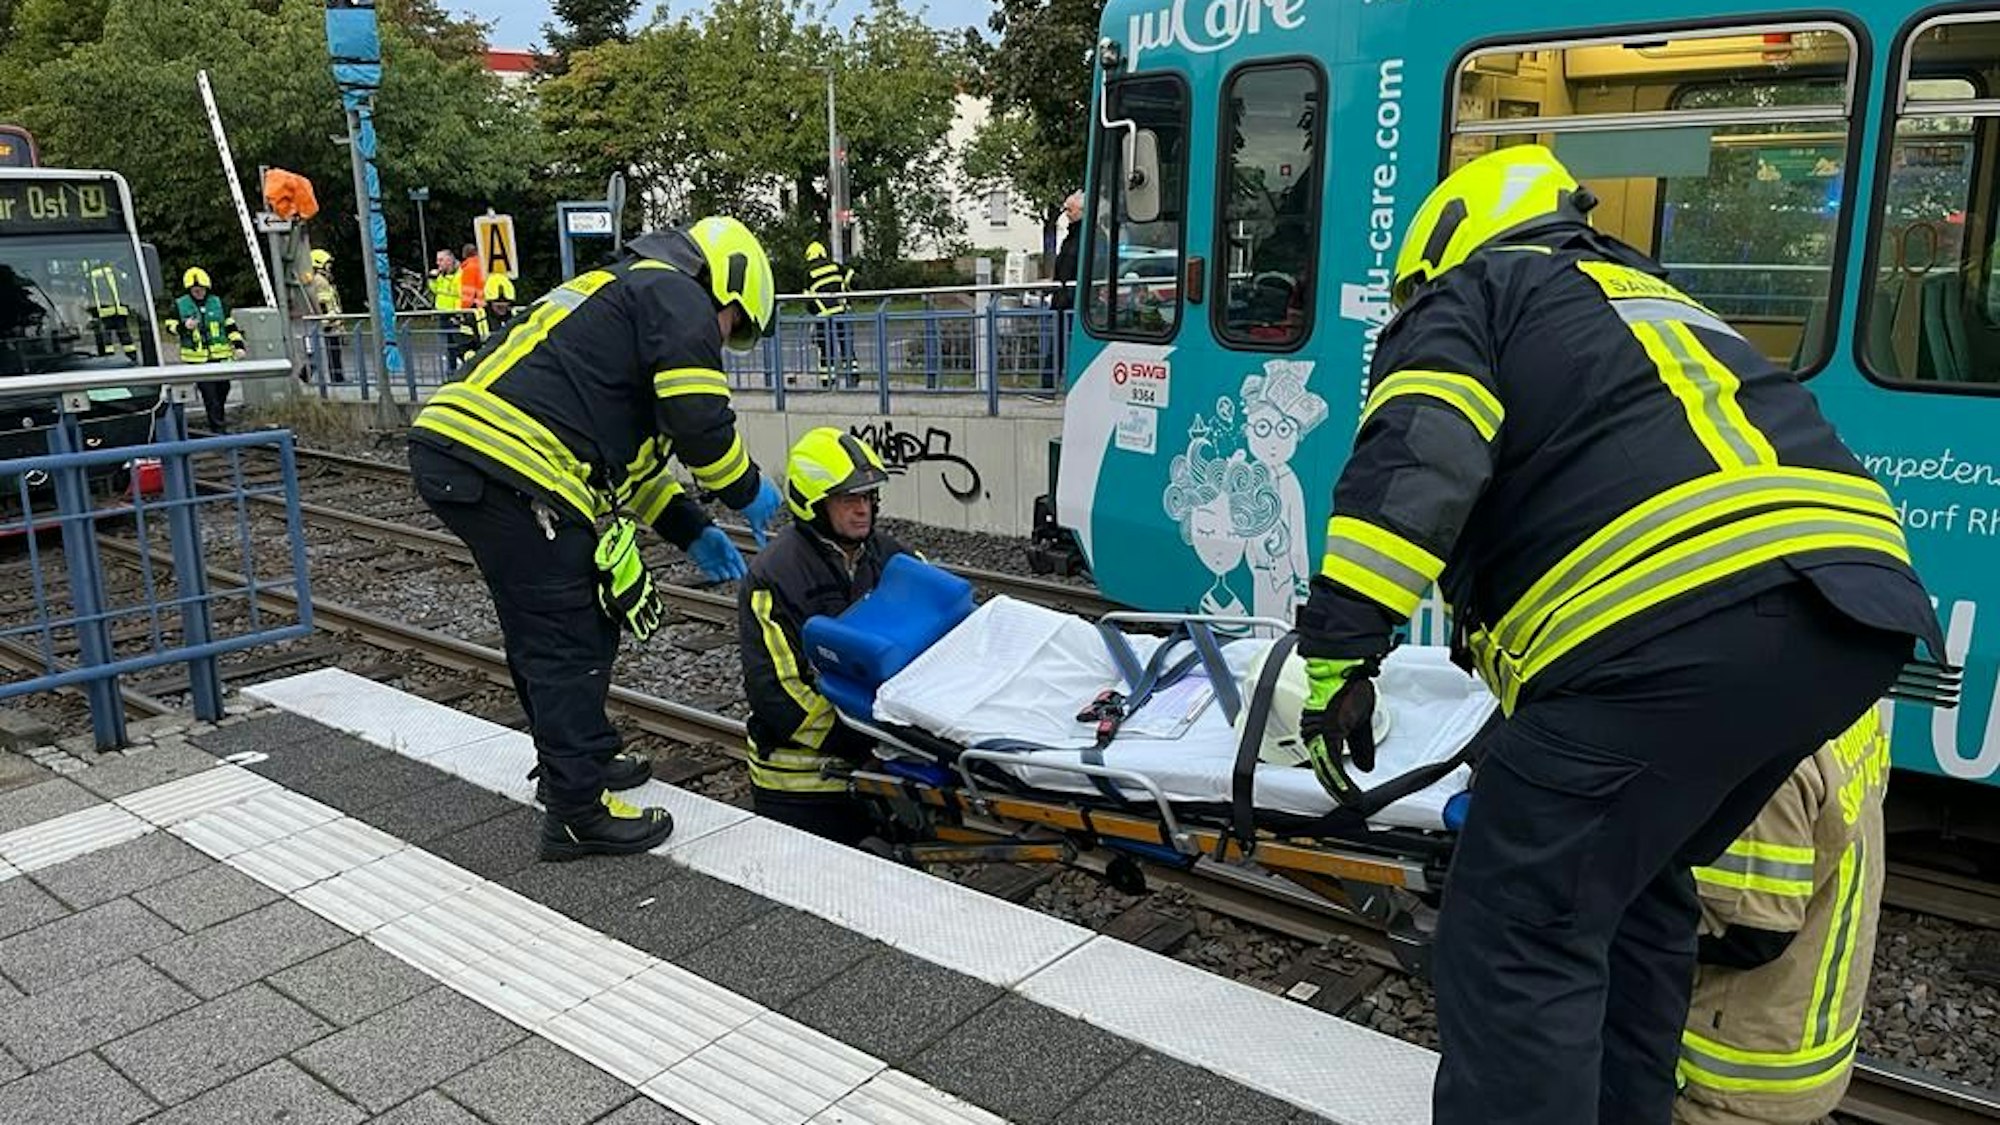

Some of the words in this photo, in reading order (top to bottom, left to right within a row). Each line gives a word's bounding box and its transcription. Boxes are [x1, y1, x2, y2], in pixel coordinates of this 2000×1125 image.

[27, 186, 69, 218] Ost
[488, 223, 511, 273] A
[1131, 364, 1166, 379] SWB
